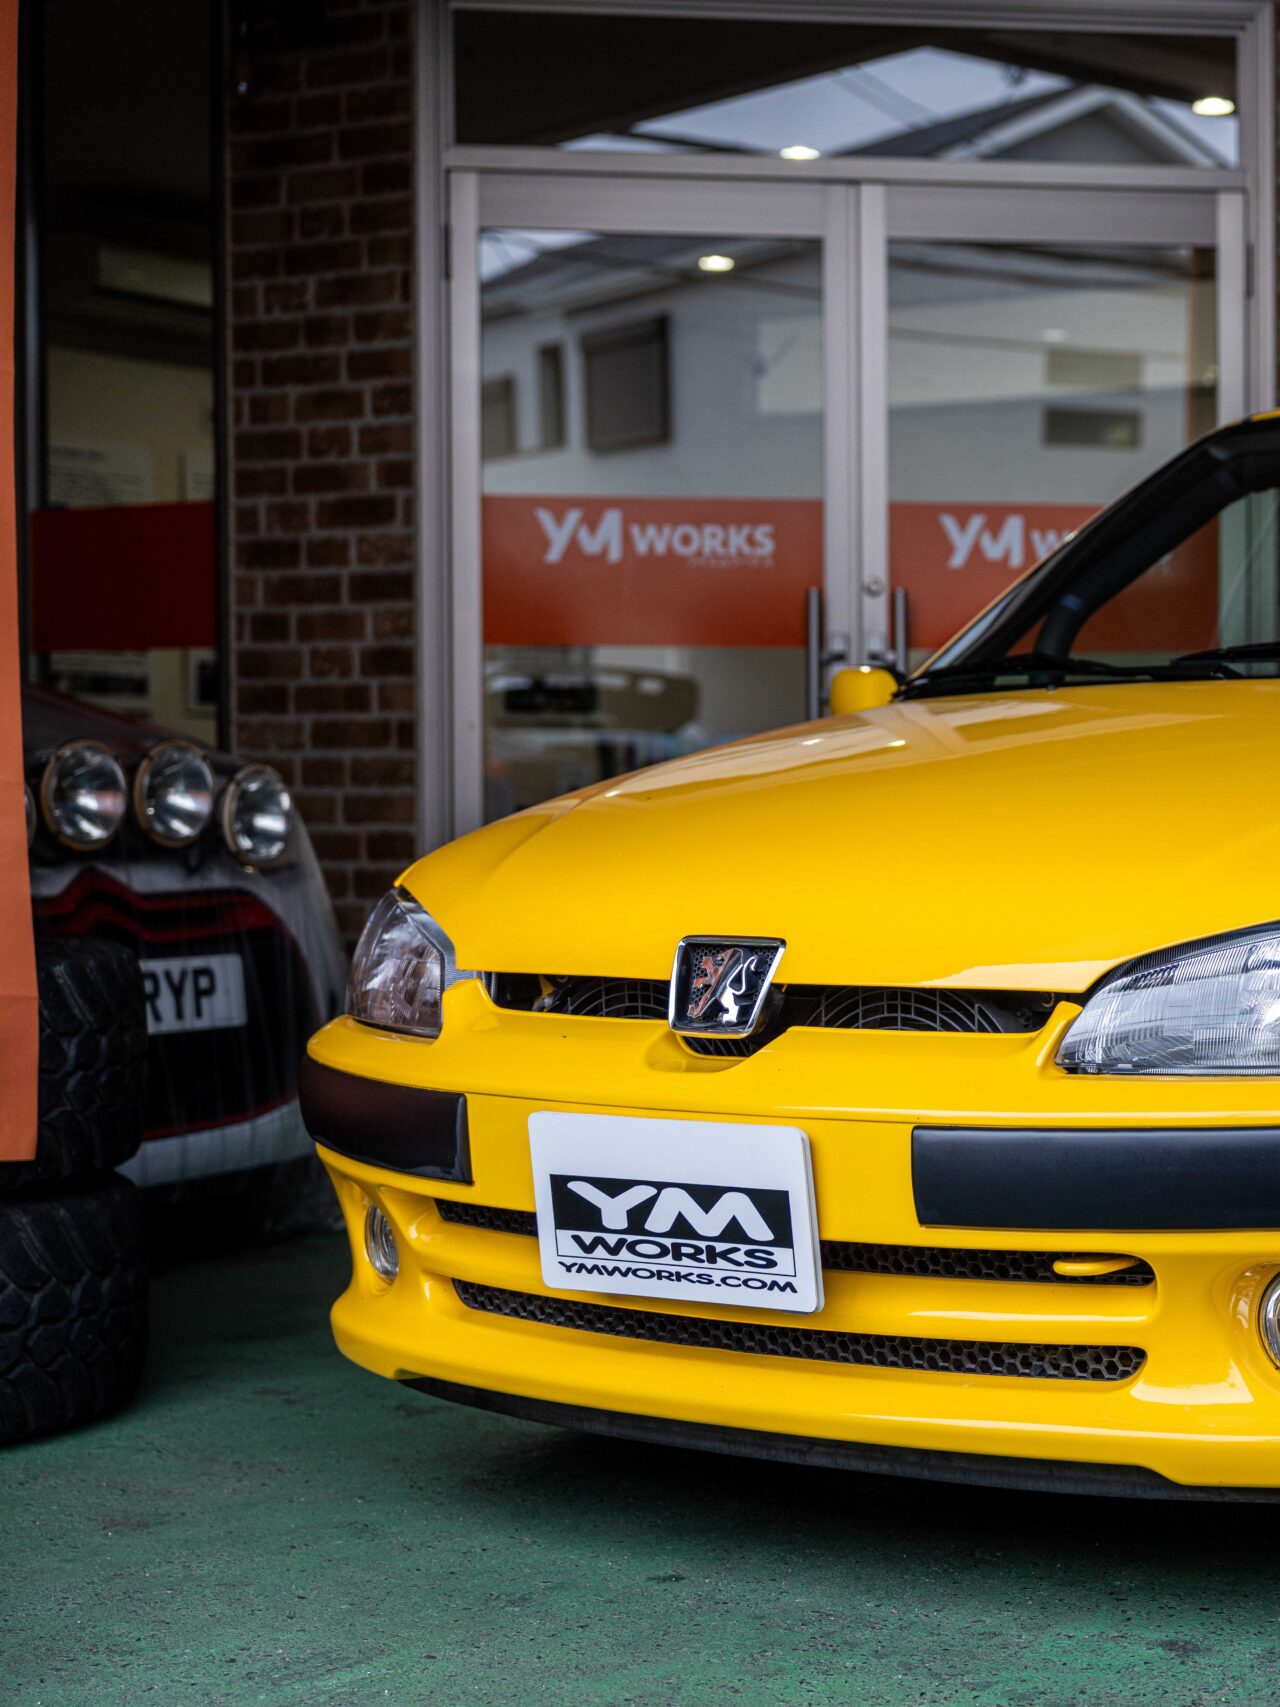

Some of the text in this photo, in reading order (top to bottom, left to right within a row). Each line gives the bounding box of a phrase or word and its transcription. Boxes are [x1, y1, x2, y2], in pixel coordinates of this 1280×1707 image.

[534, 507, 775, 565] YM WORKS
[938, 512, 1025, 570] YM
[566, 1180, 775, 1242] YM
[558, 1261, 798, 1294] YMWORKS.COM
[570, 1234, 778, 1269] WORKS
